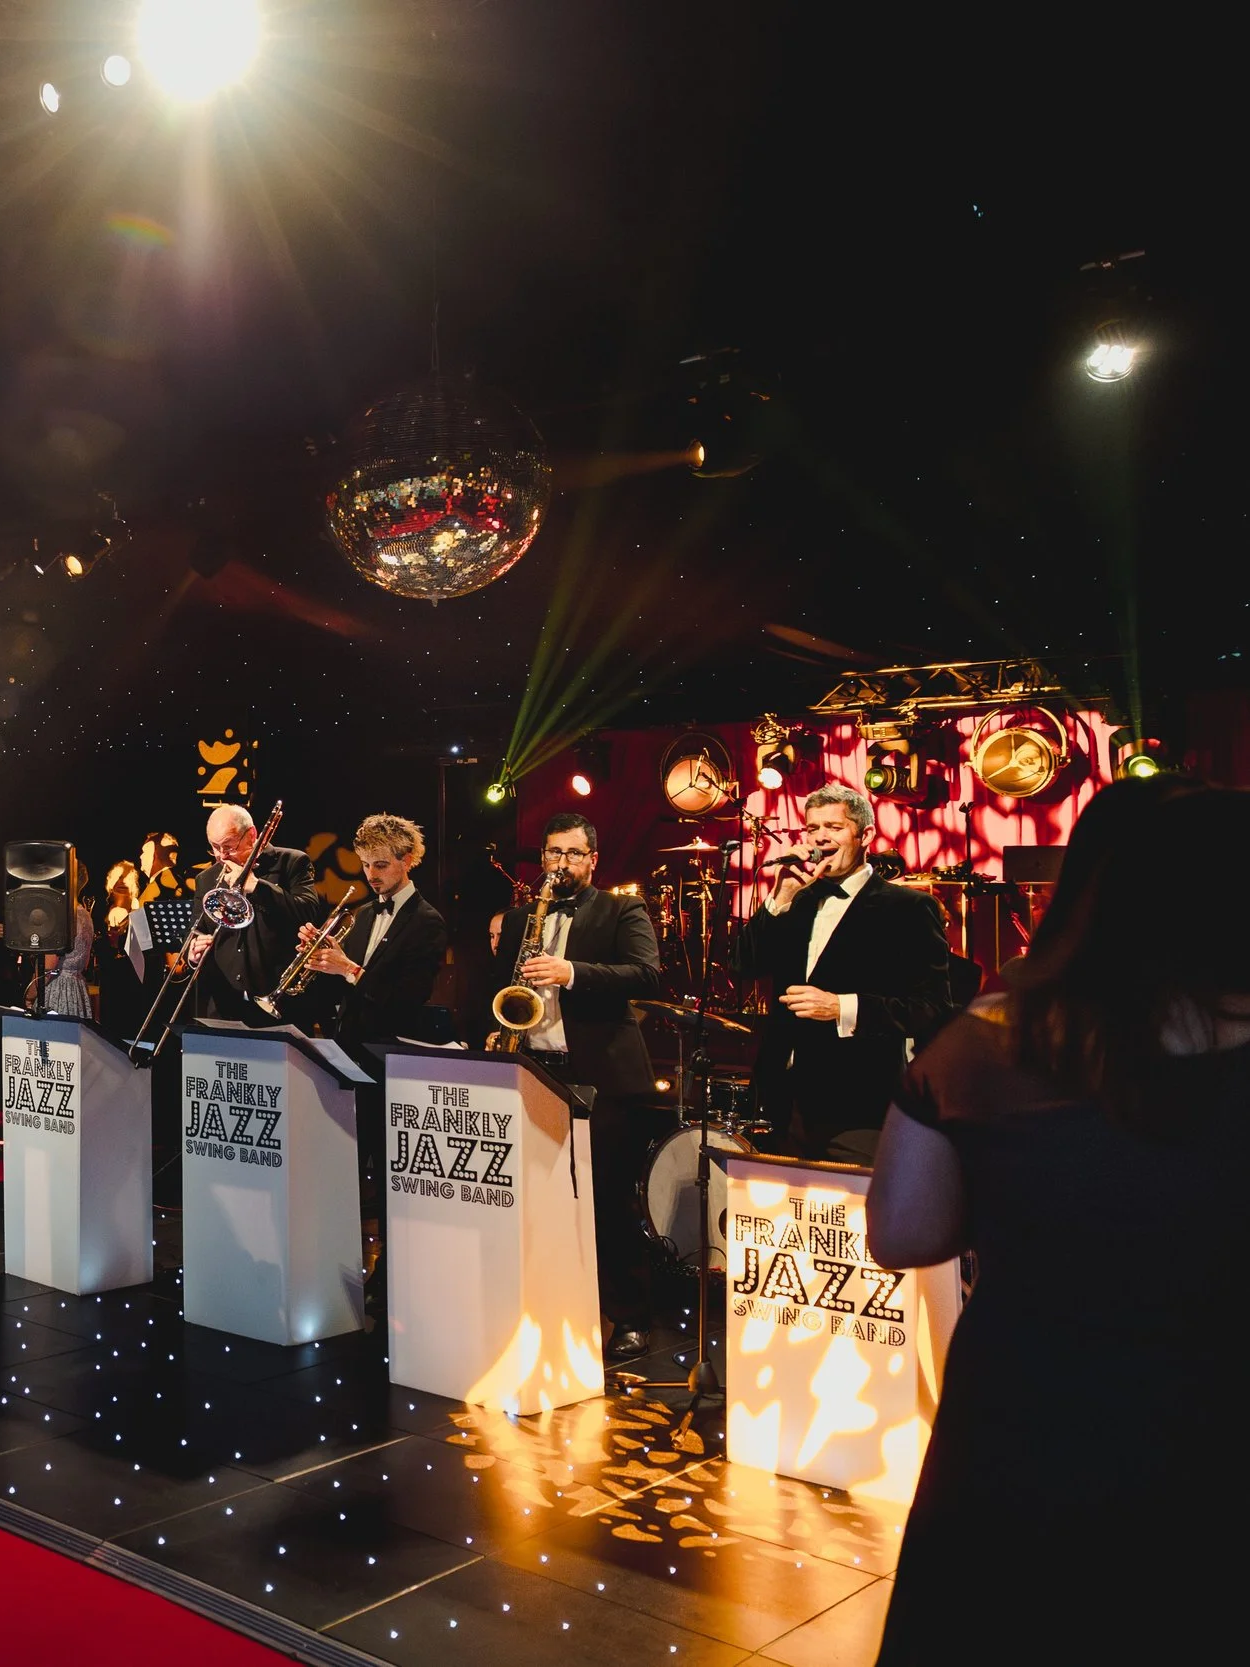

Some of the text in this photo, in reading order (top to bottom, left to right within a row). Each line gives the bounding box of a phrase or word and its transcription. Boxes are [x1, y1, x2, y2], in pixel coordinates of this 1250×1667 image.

[5, 1054, 75, 1081] FRANKLY
[215, 1061, 248, 1081] THE
[5, 1076, 75, 1119] JAZZ
[186, 1076, 282, 1108] FRANKLY
[428, 1085, 469, 1108] THE
[5, 1111, 75, 1135] SWING BAND
[185, 1101, 282, 1150] JAZZ
[391, 1103, 512, 1139] FRANKLY
[185, 1139, 282, 1168] SWING BAND
[391, 1131, 513, 1187] JAZZ
[391, 1175, 514, 1208] SWING BAND
[789, 1197, 846, 1227] THE
[735, 1214, 875, 1263] FRANK
[733, 1247, 906, 1323] JAZZ
[733, 1298, 906, 1347] SWING BAND
